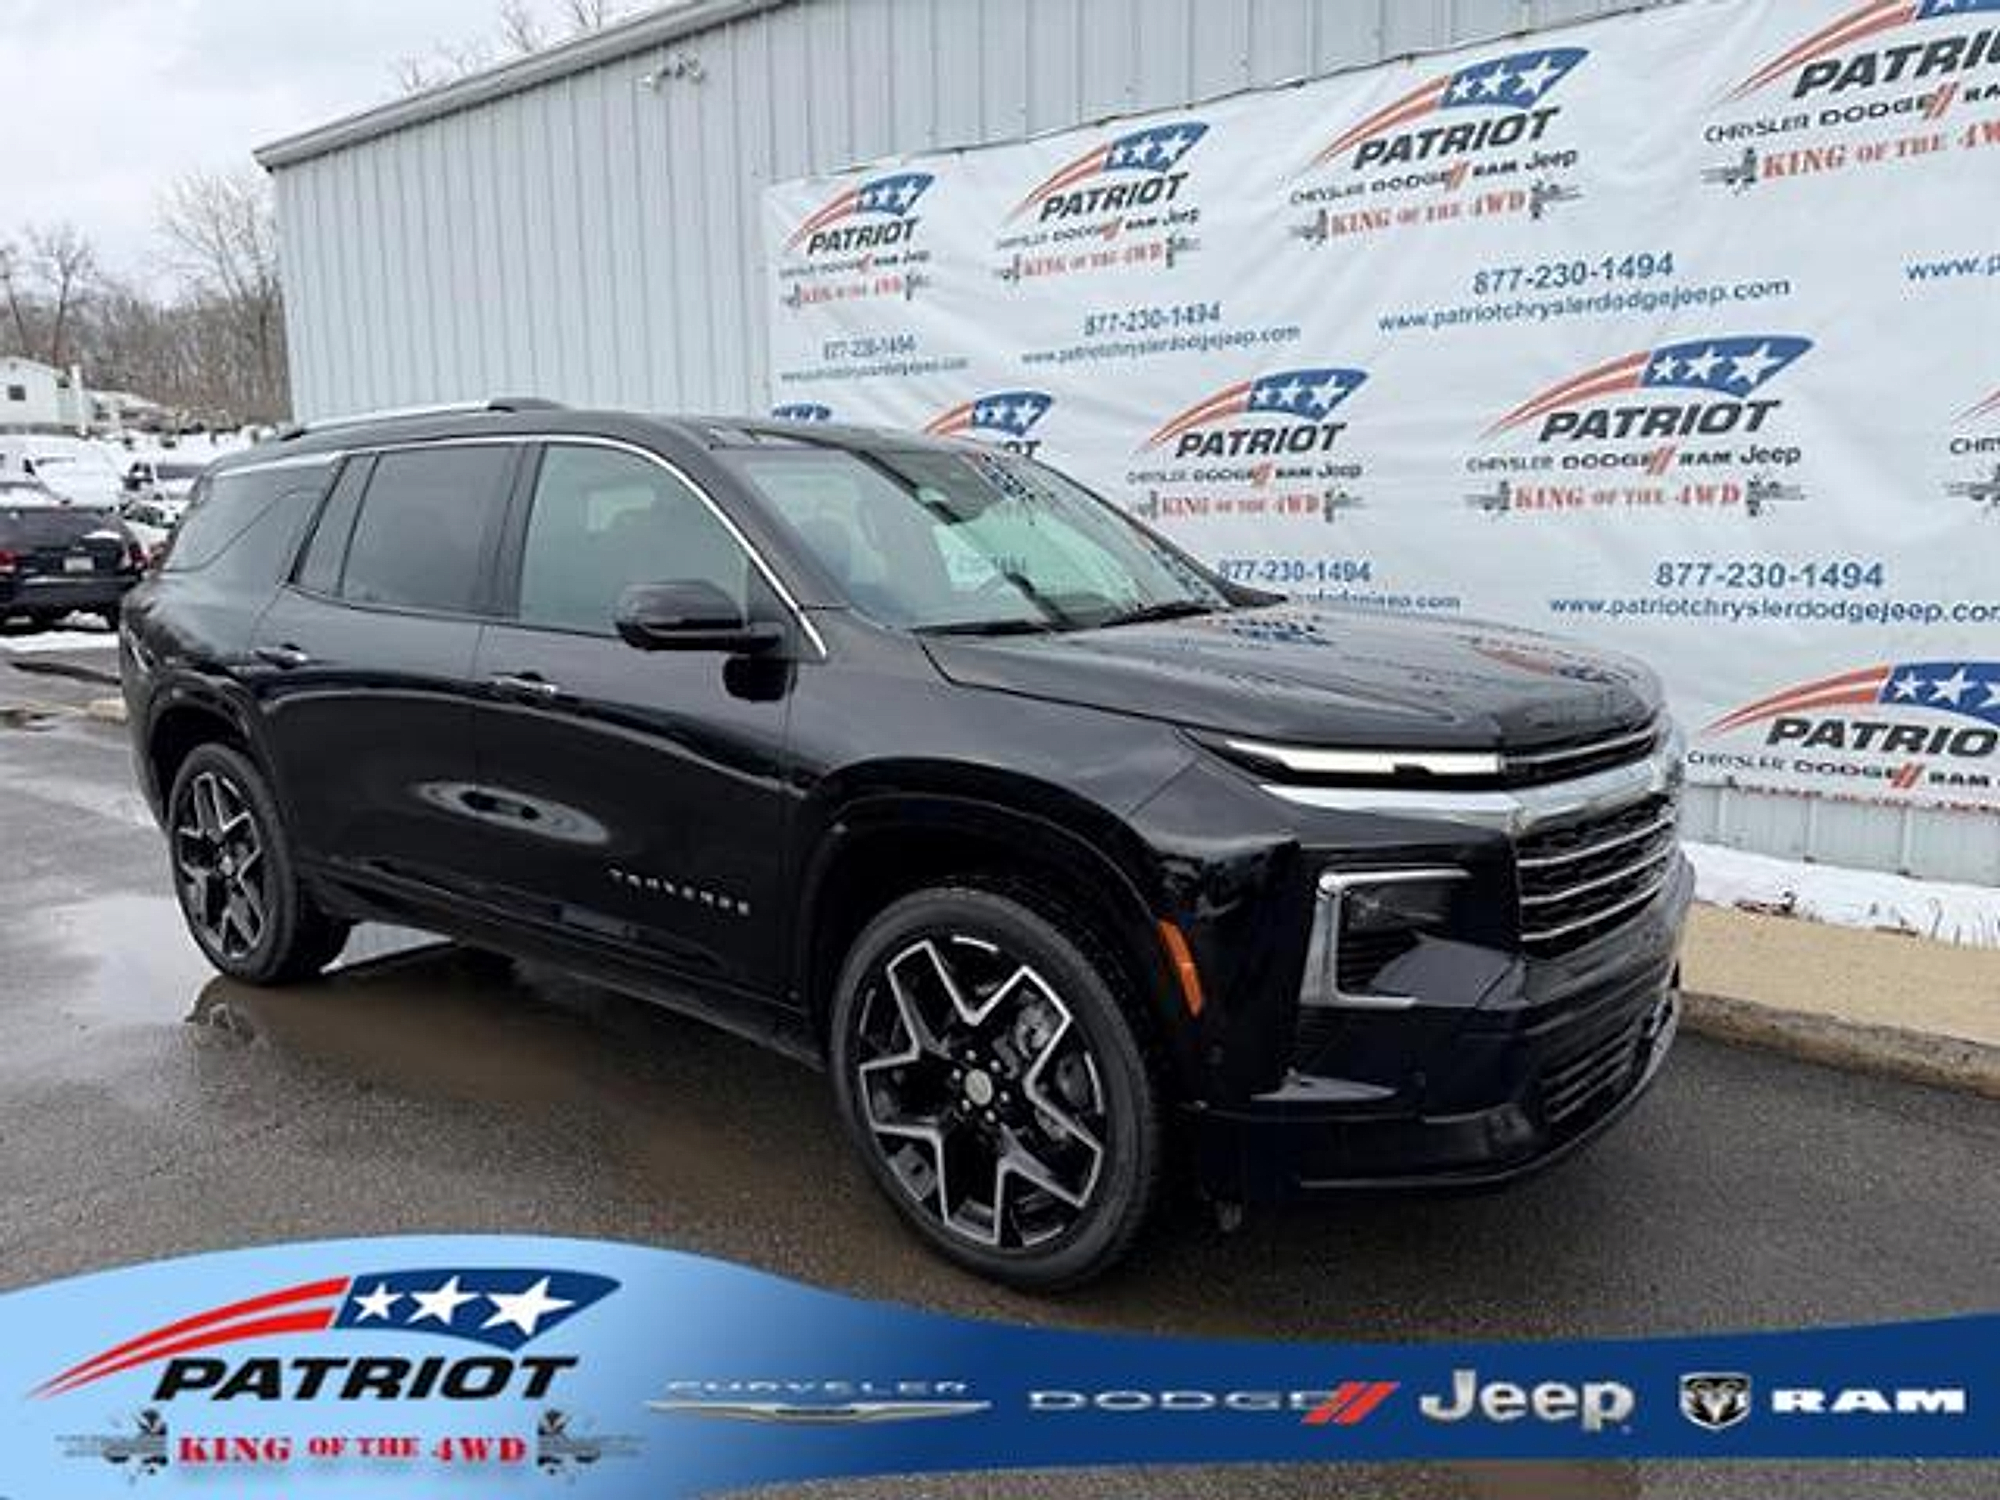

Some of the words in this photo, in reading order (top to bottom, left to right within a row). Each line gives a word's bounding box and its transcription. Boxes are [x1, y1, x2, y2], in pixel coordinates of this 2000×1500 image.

[1704, 114, 1810, 143] CHRYSLER
[1819, 94, 1939, 126] DODGE
[1966, 84, 2000, 102] RA
[1352, 106, 1561, 169] PATRIOT
[1762, 145, 1846, 178] KING
[1857, 145, 1888, 163] OF
[1898, 135, 1944, 157] THE
[1472, 161, 1518, 177] RAM
[1525, 149, 1578, 171] Jeep
[1040, 172, 1189, 222] PATRIOT
[1331, 208, 1390, 236] KING
[1397, 208, 1418, 223] OF
[1425, 202, 1462, 222] THE
[1470, 190, 1527, 216] 4WD
[807, 217, 920, 255] PATRIOT
[1472, 252, 1675, 295] 877-230-1494
[1378, 279, 1791, 333] www.patriotchryslerdodgejeep.com
[1176, 422, 1348, 458] PATRIOT
[1539, 400, 1783, 442] PATRIOT
[1466, 455, 1554, 472] CHRYSLER
[1562, 452, 1652, 470] DODGE
[1678, 451, 1733, 466] RAM
[1741, 446, 1802, 467] Jeep
[1514, 486, 1584, 510] KING
[1592, 489, 1613, 505] OF
[1622, 486, 1665, 505] THE
[1655, 562, 1885, 590] 877-230-1494
[1765, 717, 1998, 758] PATRIO
[1793, 759, 1900, 780] DODGE
[1929, 771, 1989, 788] RAM
